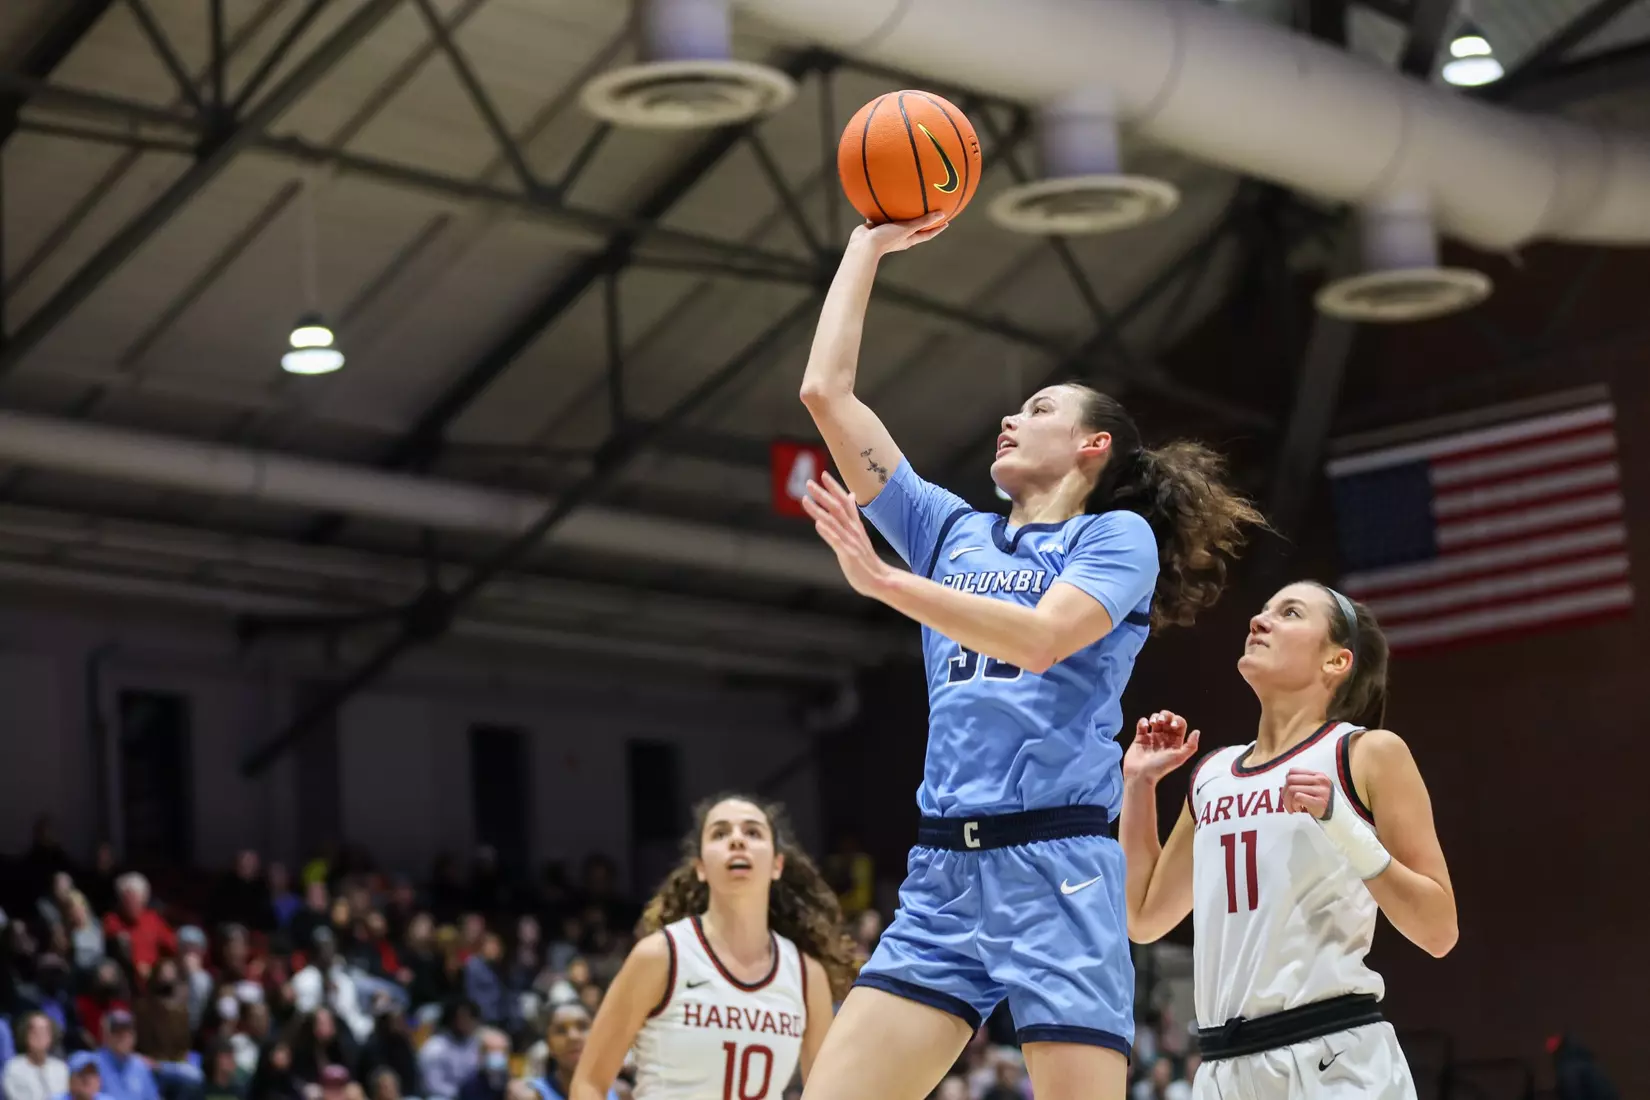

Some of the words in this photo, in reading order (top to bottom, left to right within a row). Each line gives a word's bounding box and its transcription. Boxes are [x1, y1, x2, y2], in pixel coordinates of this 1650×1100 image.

[941, 569, 1056, 595] COLUMBI
[1196, 786, 1308, 831] ARVA
[964, 821, 980, 848] C
[1220, 829, 1259, 914] 11
[722, 1040, 774, 1100] 10
